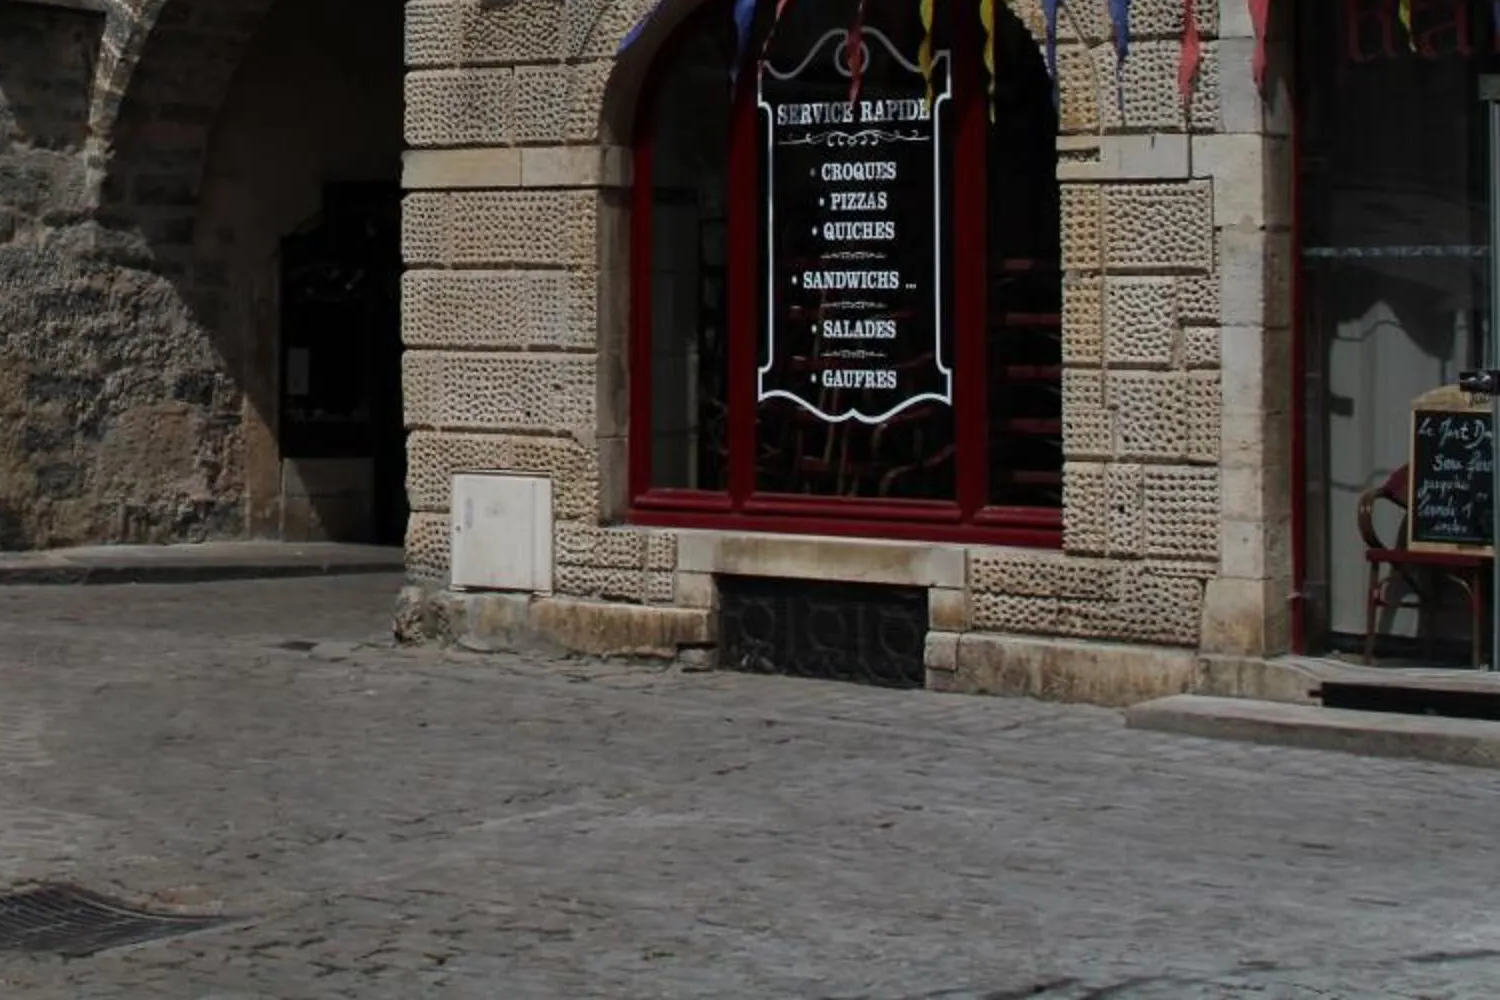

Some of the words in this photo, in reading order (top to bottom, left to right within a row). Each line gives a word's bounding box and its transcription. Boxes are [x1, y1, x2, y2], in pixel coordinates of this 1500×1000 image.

[777, 101, 854, 126] SERVICE
[859, 97, 931, 122] RAPIDE
[821, 161, 897, 181] CROQUES
[830, 191, 888, 211] PIZZAS
[823, 220, 896, 241] QUICHES
[802, 270, 900, 290] SANDWICHS
[822, 319, 897, 340] SALADES
[822, 368, 897, 389] GAUFRES
